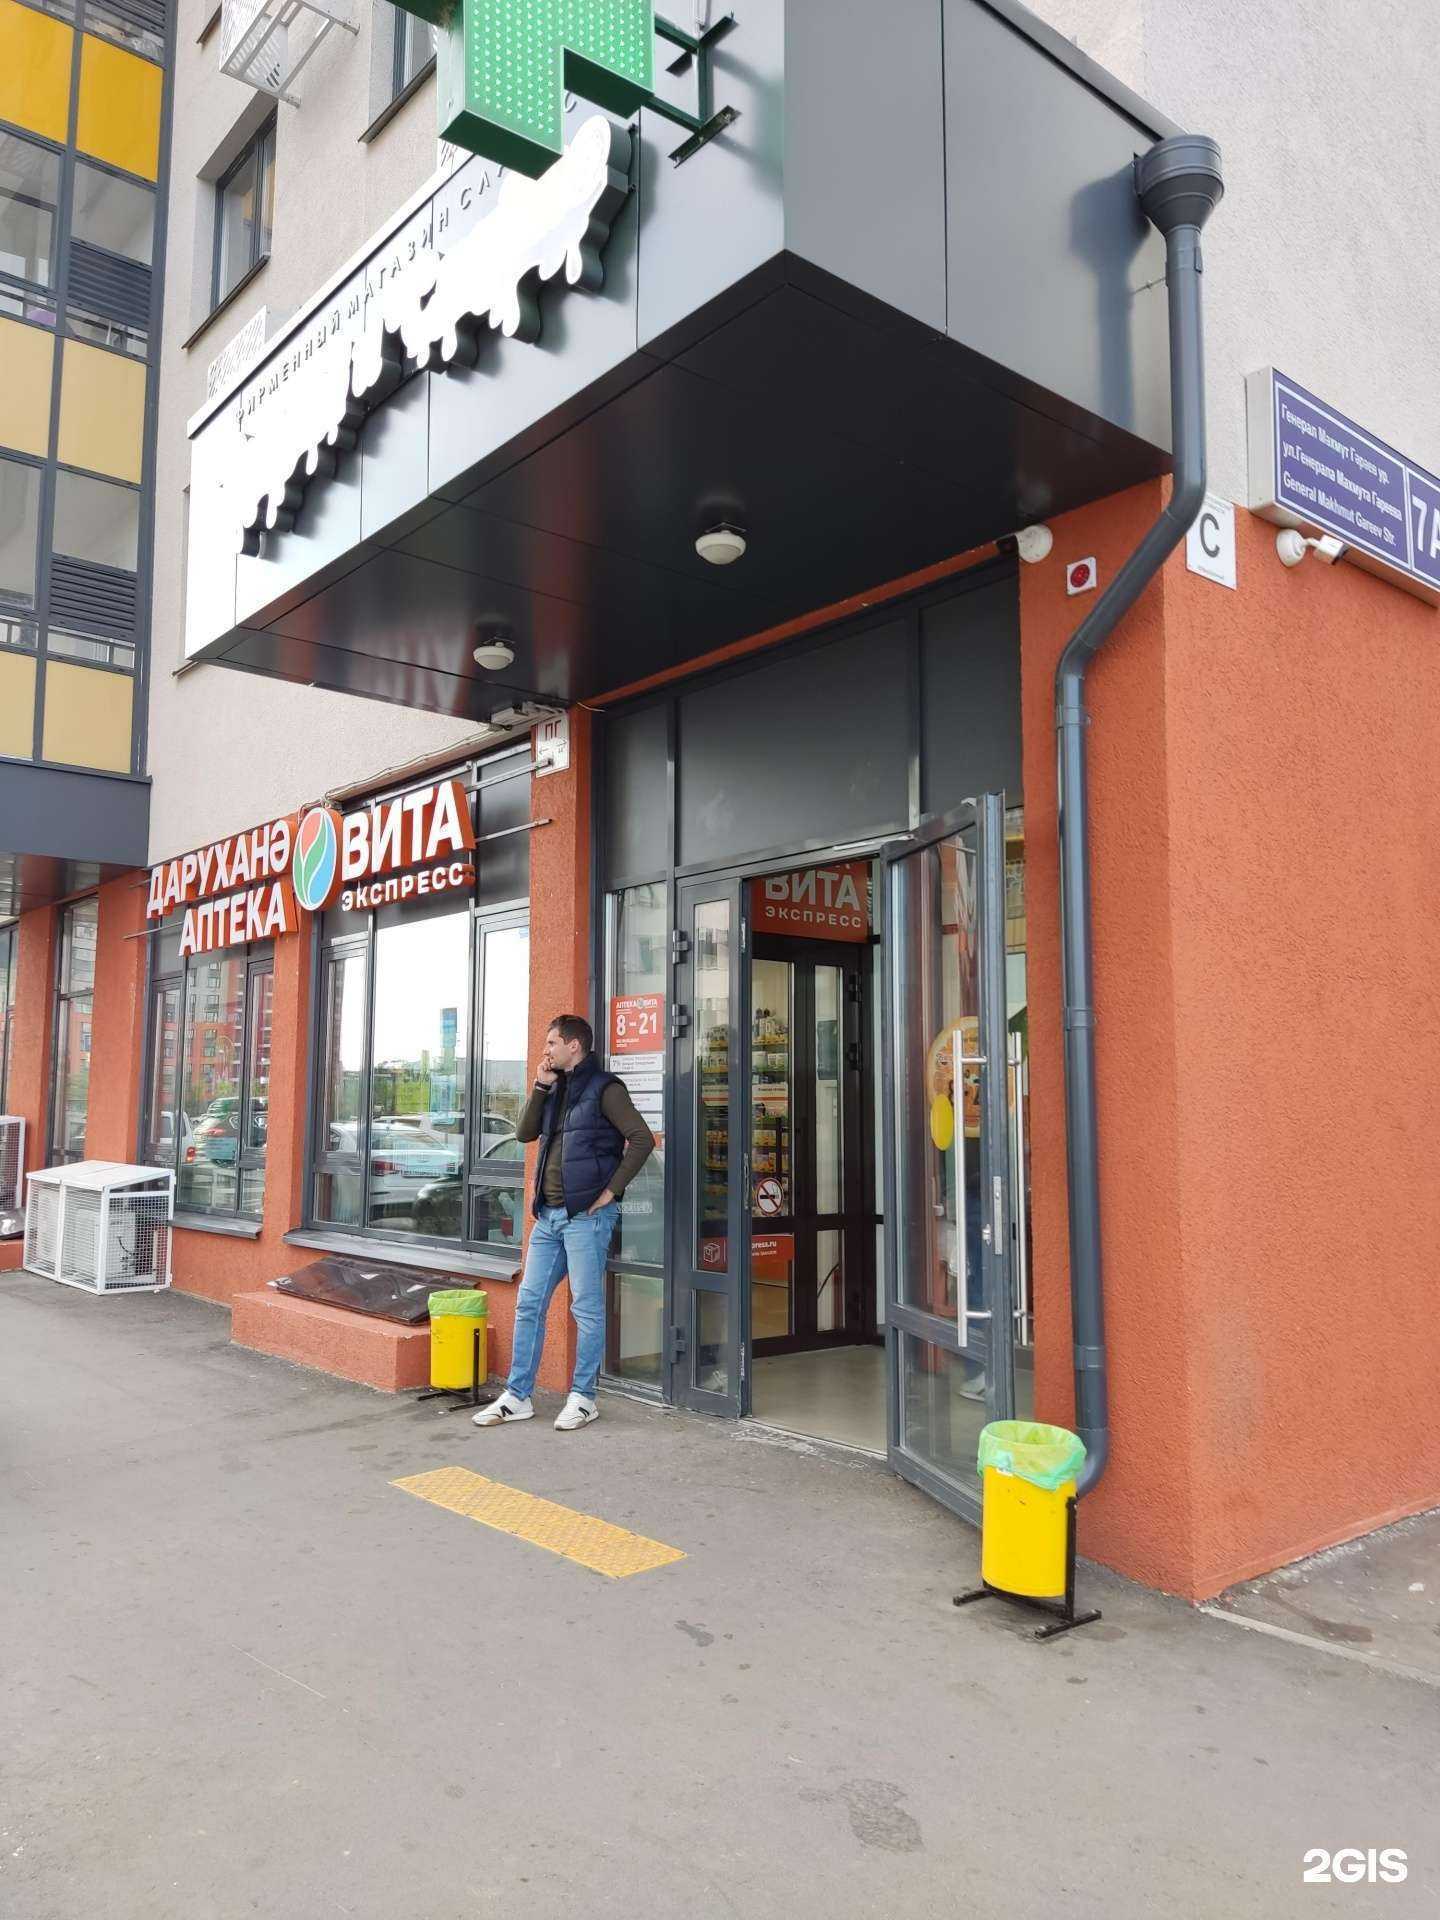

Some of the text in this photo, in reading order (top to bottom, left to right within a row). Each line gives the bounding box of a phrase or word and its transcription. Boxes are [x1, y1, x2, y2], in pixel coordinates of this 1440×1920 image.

[1281, 403, 1318, 440] Генерал
[1283, 470, 1317, 502] General
[1318, 488, 1355, 524] Makhmut
[341, 780, 465, 882] ВИТА
[147, 820, 291, 919] ДАРУХАНӘ
[341, 862, 464, 912] ЭКСПРЕСС
[765, 869, 861, 912] ВИТА
[178, 881, 287, 957] АПТЕКА
[765, 905, 862, 928] ЭКСПРЕСС
